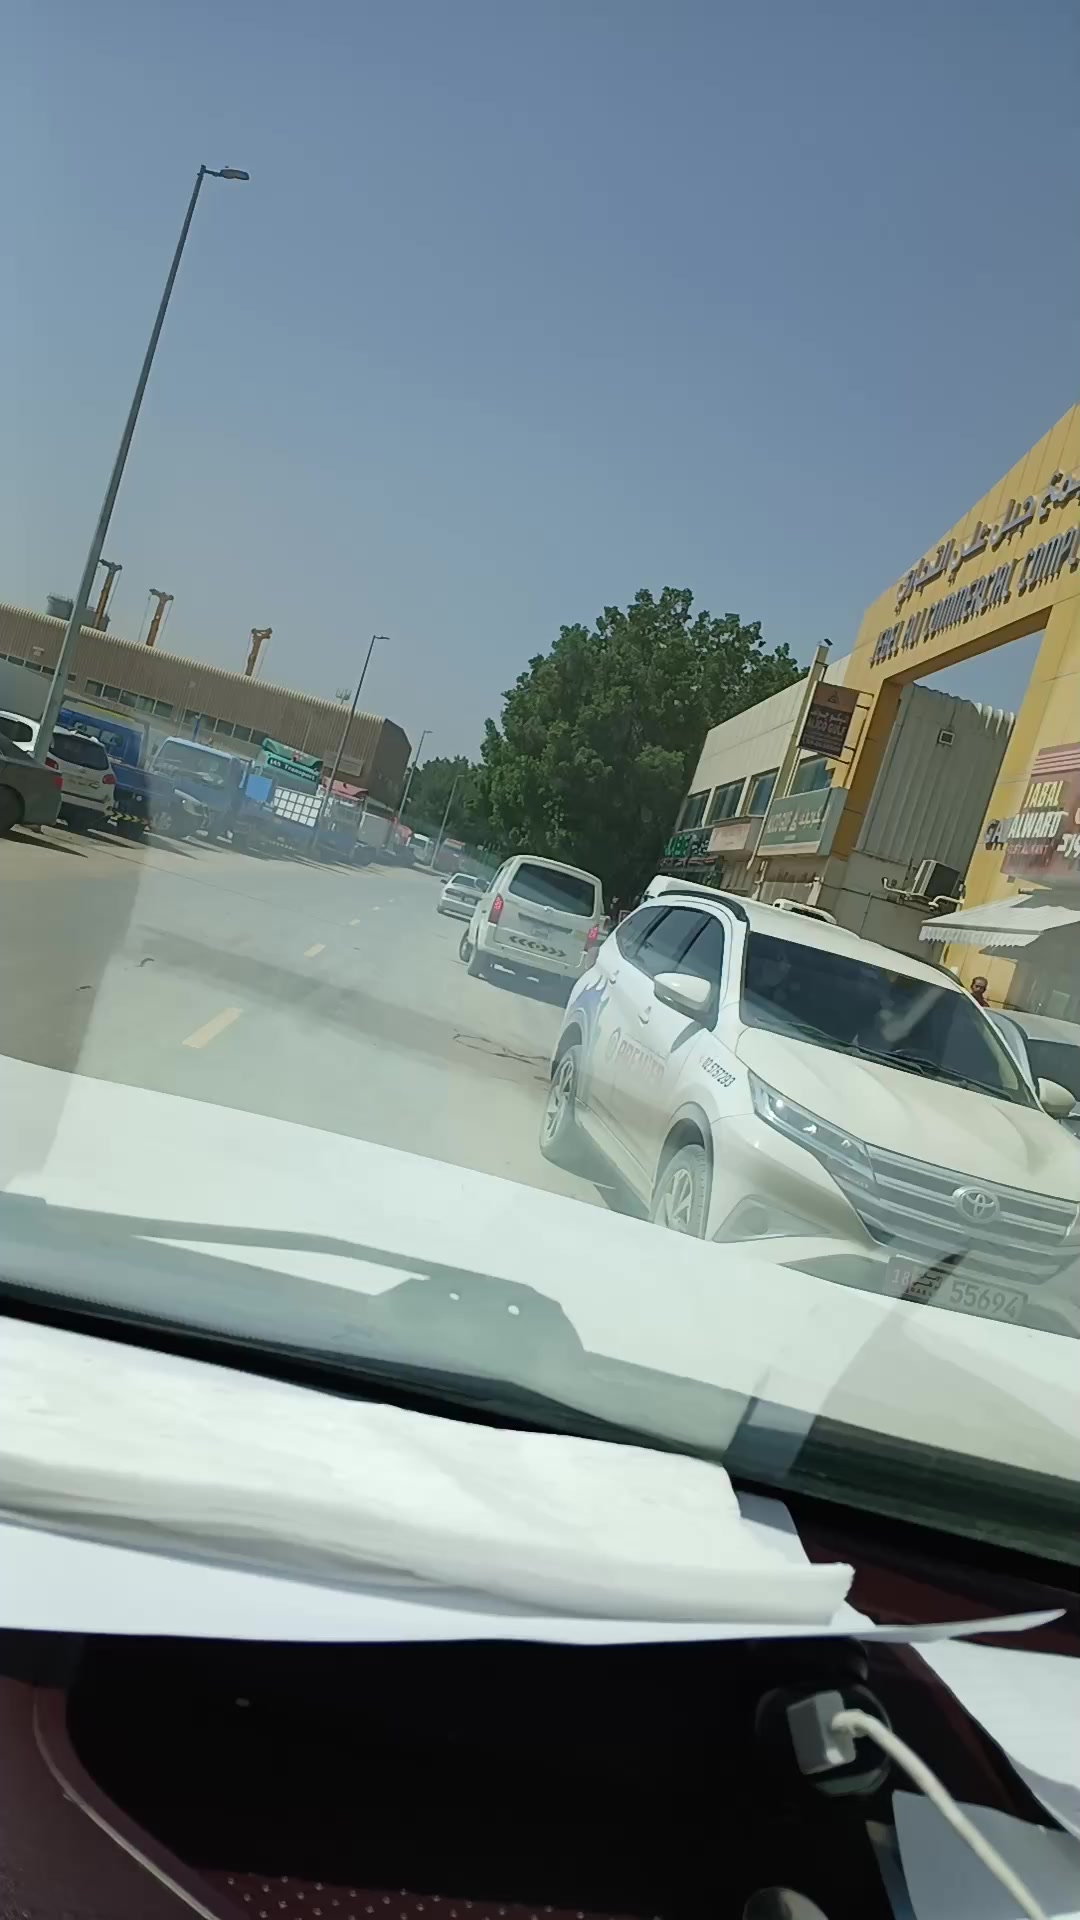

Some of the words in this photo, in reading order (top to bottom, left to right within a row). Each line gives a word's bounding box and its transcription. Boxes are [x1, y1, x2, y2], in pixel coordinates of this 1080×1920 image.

[869, 621, 905, 668] JEBEL
[922, 558, 1018, 643] COMMERCIAL
[1024, 780, 1064, 808] JABAL
[1008, 811, 1066, 839] ALWARD
[891, 1268, 911, 1286] 18
[950, 1279, 1019, 1319] 55694
